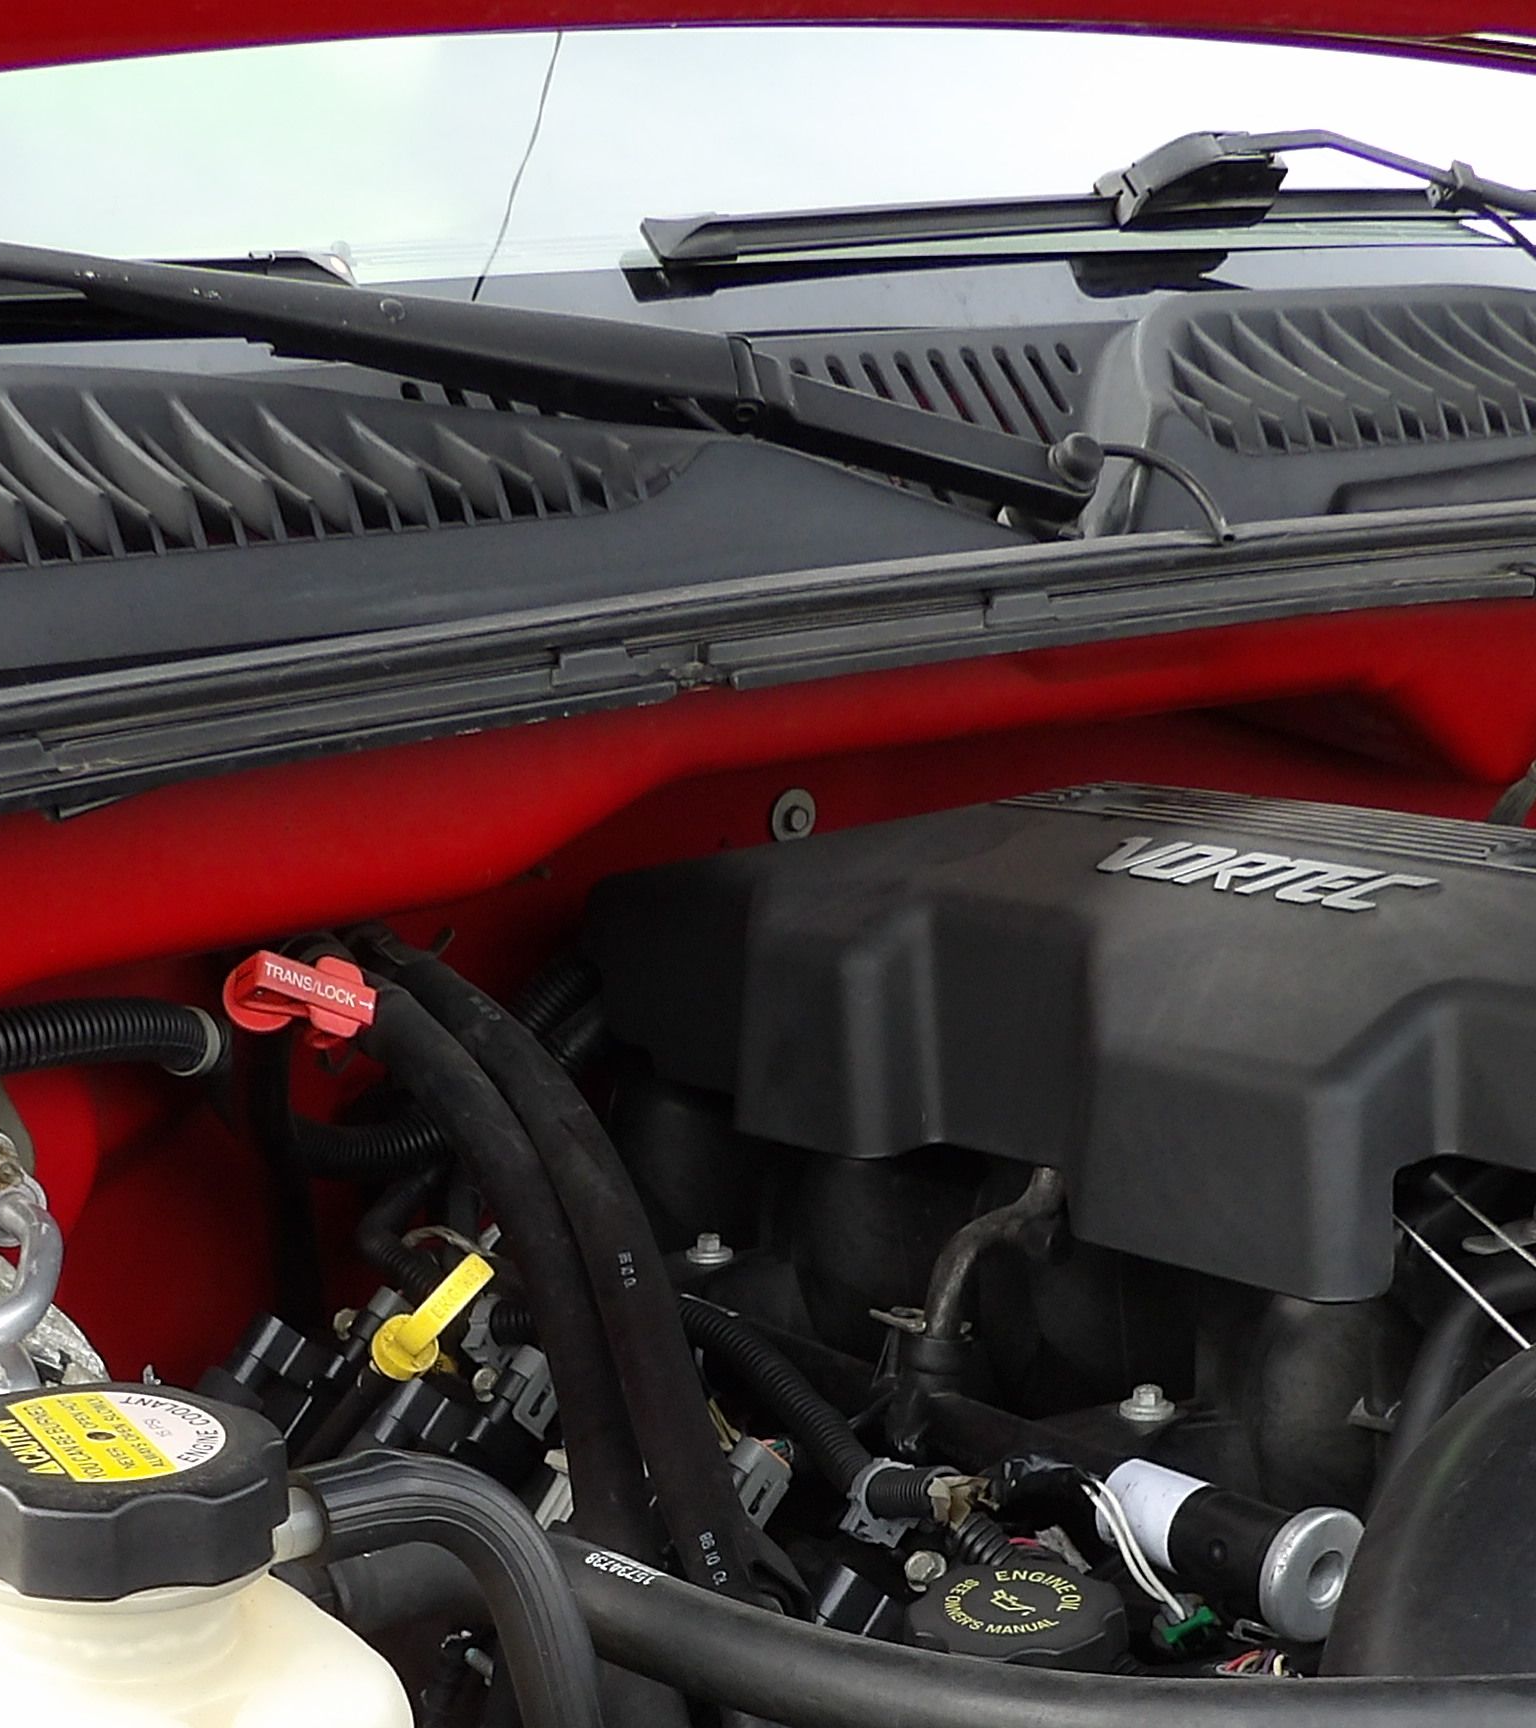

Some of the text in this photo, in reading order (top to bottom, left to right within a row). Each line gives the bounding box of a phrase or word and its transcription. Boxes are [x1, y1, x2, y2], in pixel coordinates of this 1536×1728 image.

[1096, 835, 1441, 913] VORTEC
[263, 960, 358, 1008] TRANS/LOCK
[51, 1433, 77, 1446] BE
[115, 1423, 141, 1442] OPEN
[119, 1395, 219, 1464] ENGINE COOLANT
[64, 1445, 93, 1463] CAN
[106, 1447, 137, 1470] NEVER
[131, 1443, 166, 1467] ALWAYS
[78, 1460, 108, 1479] YOU
[584, 1551, 657, 1586] 15734738
[994, 1569, 1082, 1613] ENGINE OIL
[949, 1578, 981, 1596] SEE
[984, 1618, 1060, 1635] MANUAL
